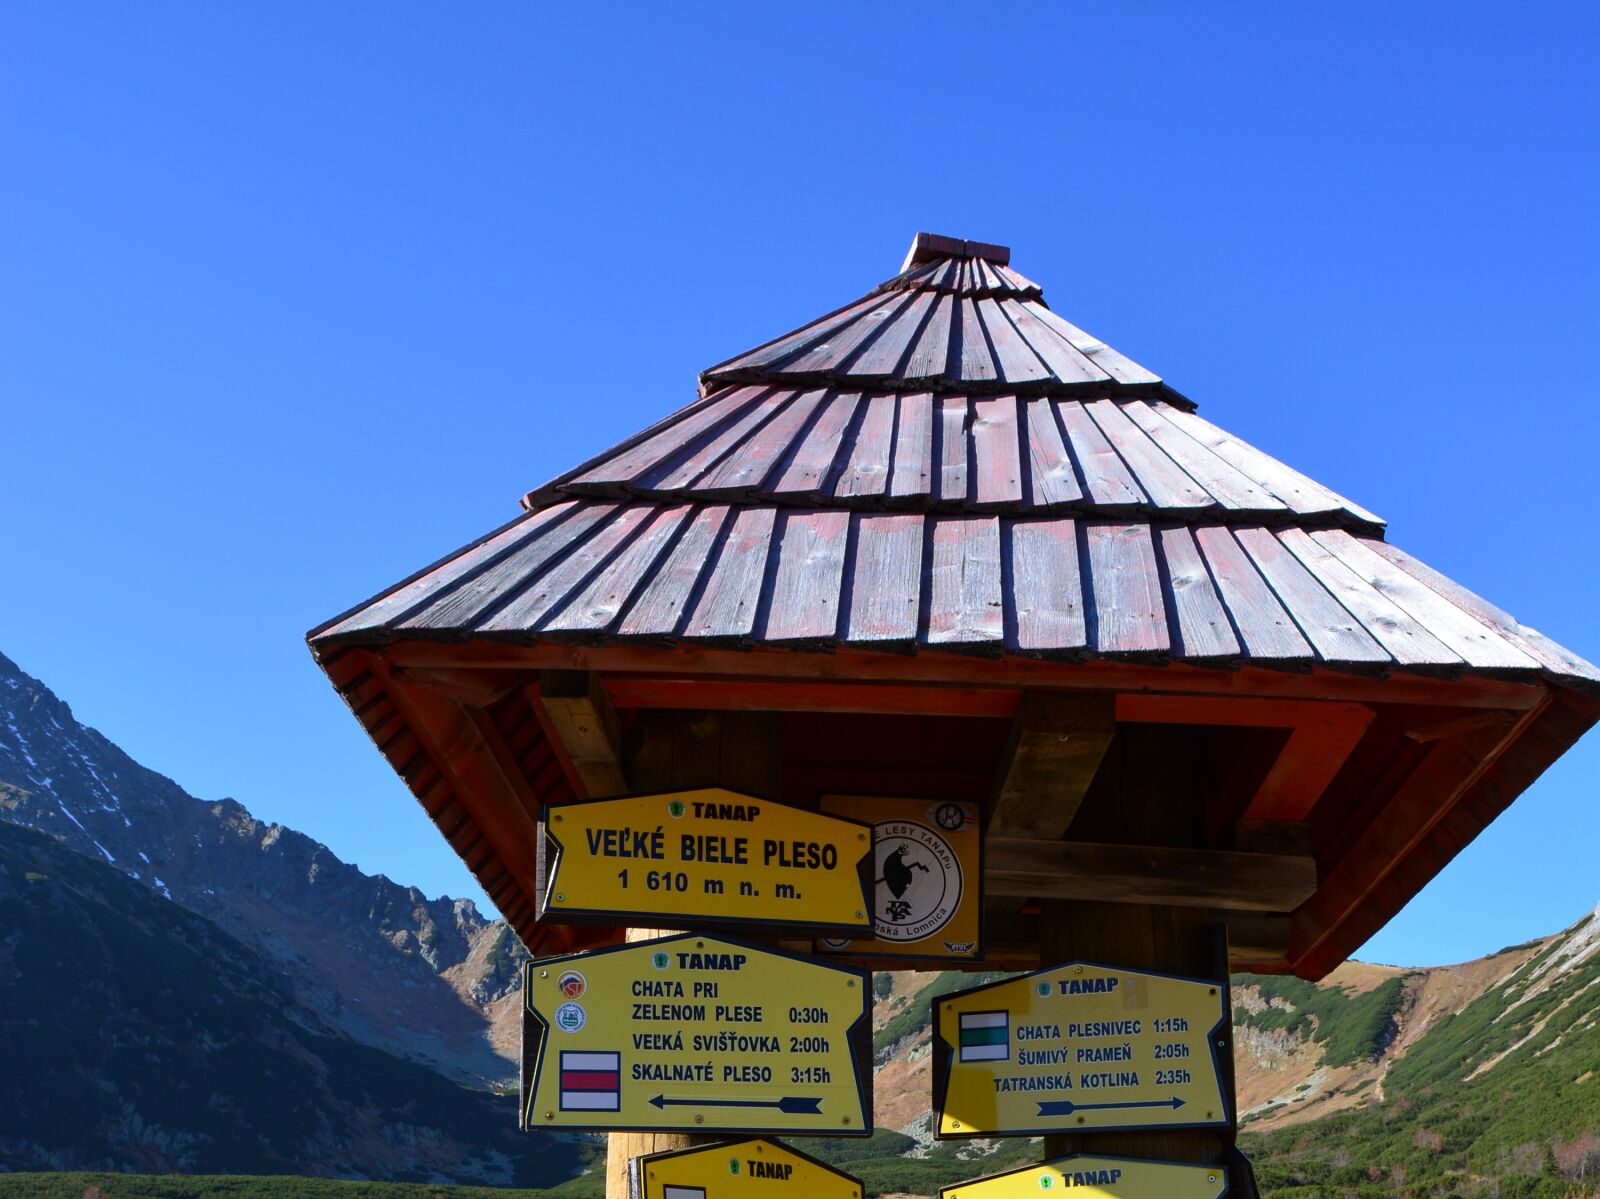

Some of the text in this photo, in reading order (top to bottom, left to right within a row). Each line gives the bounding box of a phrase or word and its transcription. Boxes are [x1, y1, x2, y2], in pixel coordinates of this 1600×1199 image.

[692, 802, 760, 822] TANAP
[885, 826, 916, 836] LESY
[586, 826, 838, 870] VEĽKÉ BIELE PLESO
[618, 870, 802, 899] 1 610 m n. m.
[906, 908, 947, 936] Lomnica
[676, 953, 747, 970] TANAP
[631, 980, 718, 998] CHATA PRI
[1058, 977, 1118, 995] TANAP
[632, 1004, 828, 1024] ZELENOM PLESE 0:30h
[1016, 1018, 1188, 1040] CHATA PLESNIVEC 1:15h
[632, 1031, 830, 1053] VEĽKÁ SVIŠŤOVKA 2:00h
[1018, 1043, 1189, 1066] ŠUMIVÝ PRAMEŇ 2:05h
[631, 1061, 831, 1084] SKALNATÉ PLESO 3:15h
[994, 1070, 1191, 1092] TATRANSKÁ KOTLINA 2:35h
[747, 1160, 792, 1180] TANAP
[1062, 1169, 1122, 1187] TANAP
